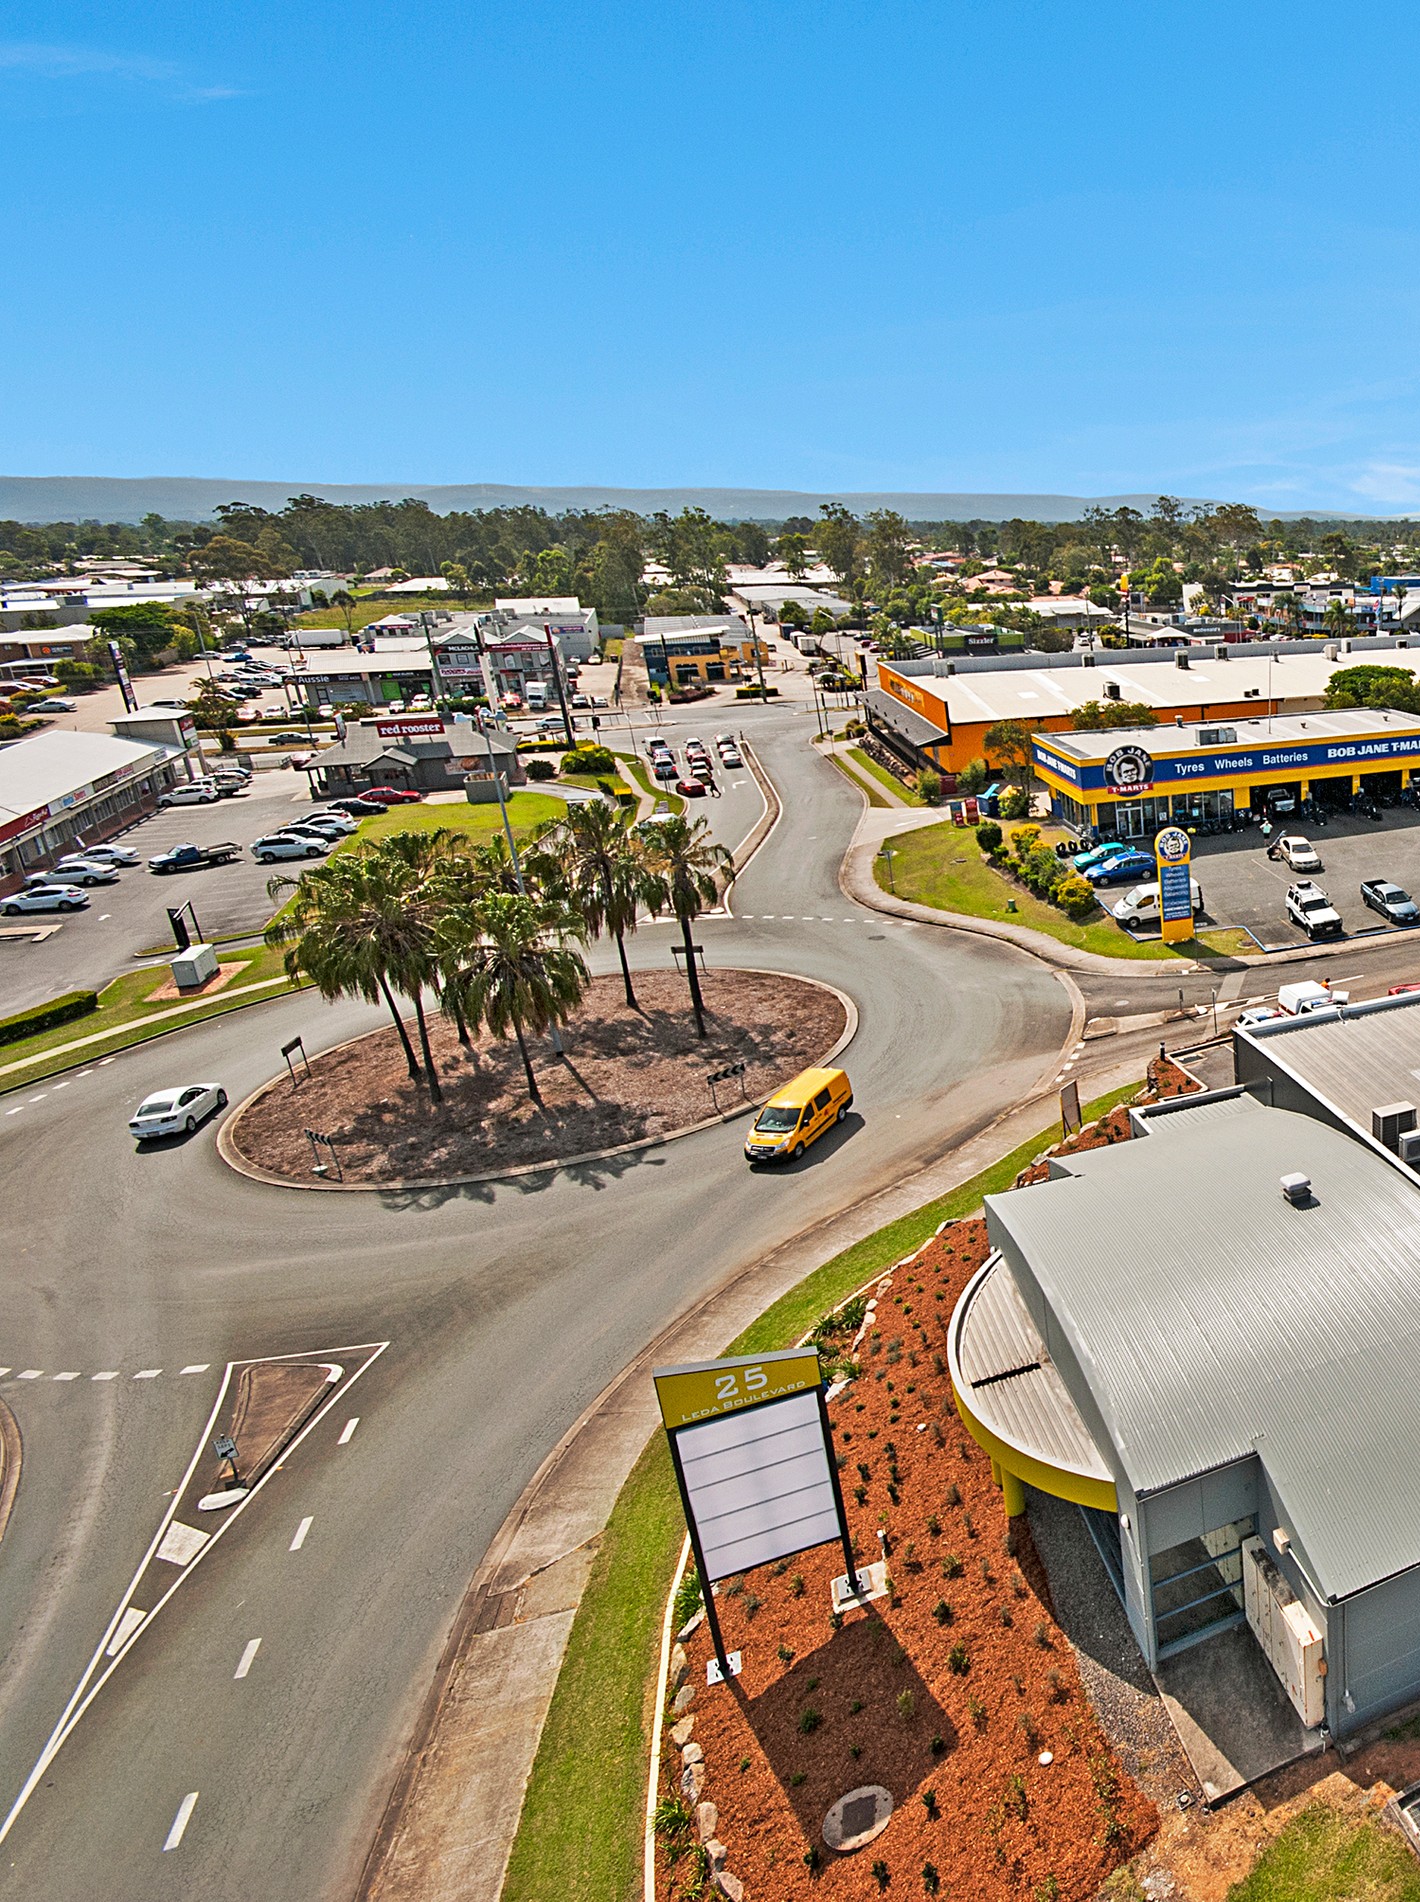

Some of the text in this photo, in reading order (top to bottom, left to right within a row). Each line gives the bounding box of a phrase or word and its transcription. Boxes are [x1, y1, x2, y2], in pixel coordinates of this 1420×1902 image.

[298, 676, 330, 684] Aussie
[380, 723, 441, 735] red rooster
[1327, 747, 1355, 758] BOB
[1357, 743, 1389, 756] JANE
[1106, 747, 1153, 772] BOB JANE
[1175, 752, 1308, 774] Tyres Wheels Batteries
[1112, 784, 1149, 793] T-MARTS
[1160, 832, 1188, 848] BOB JANE
[715, 1366, 768, 1400] 25
[682, 1380, 806, 1422] LEDA BOULEVARD
